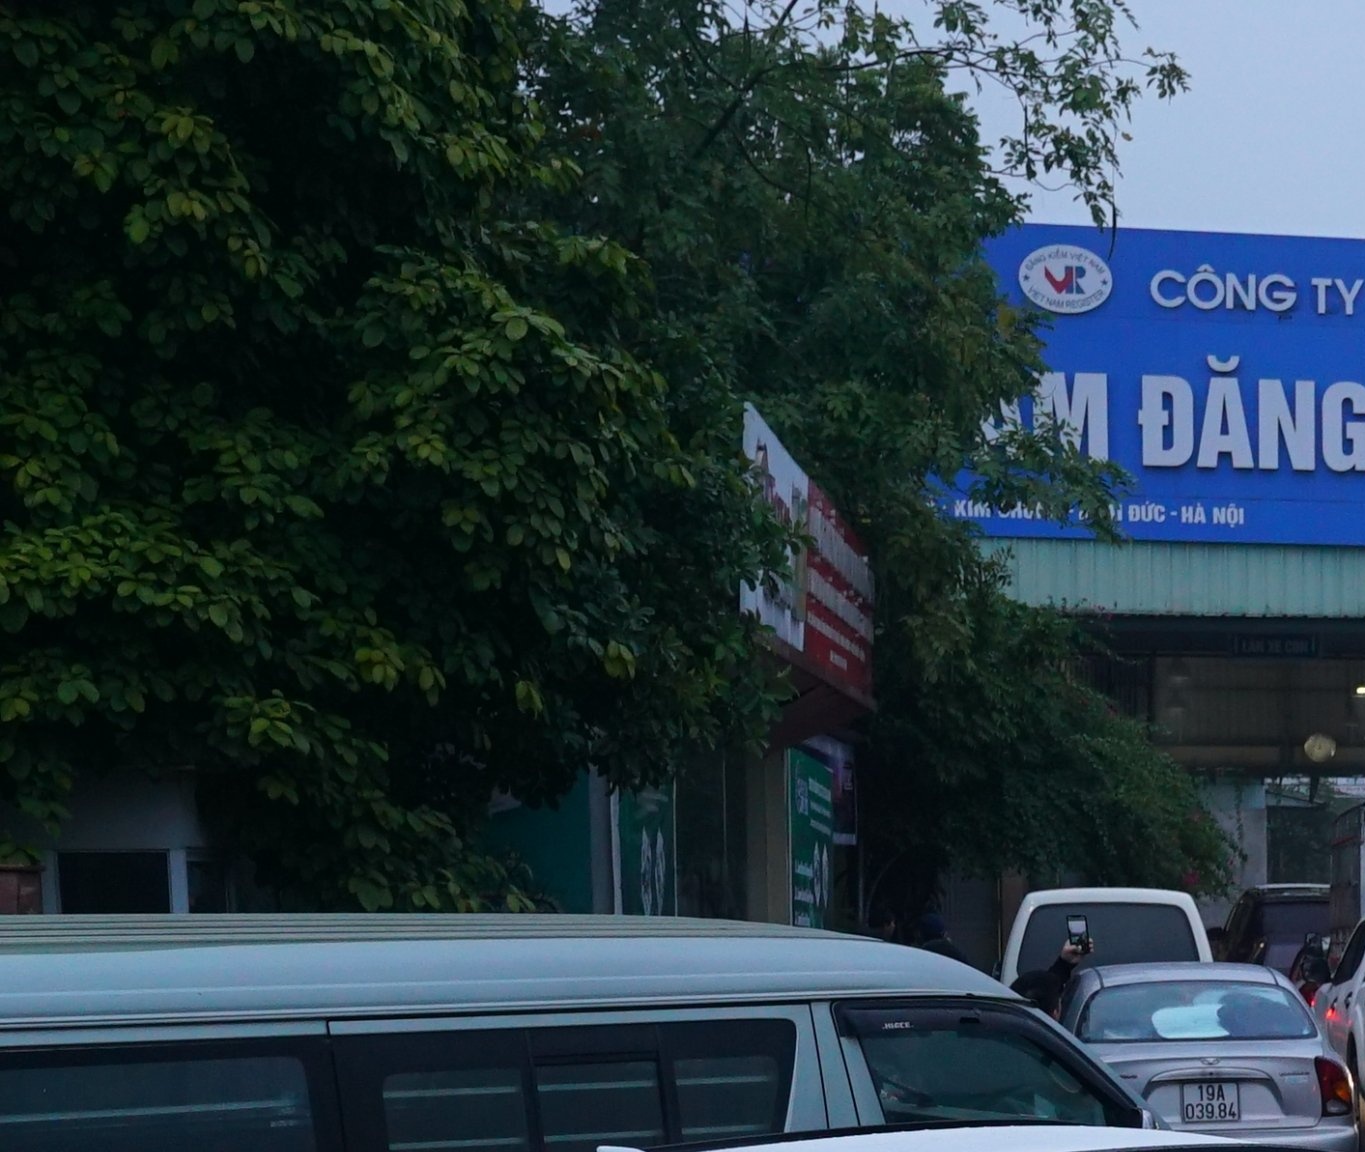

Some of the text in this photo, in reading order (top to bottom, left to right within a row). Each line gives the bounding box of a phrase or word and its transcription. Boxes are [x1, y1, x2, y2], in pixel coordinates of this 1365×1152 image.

[1150, 263, 1298, 313] CÔNG
[1312, 276, 1364, 318] TY
[1128, 500, 1166, 524] ĐỨC
[1181, 503, 1206, 525] HÀ
[1213, 502, 1245, 528] NỘI
[1198, 1083, 1226, 1102] 19A
[1185, 1101, 1238, 1120] 039.84
